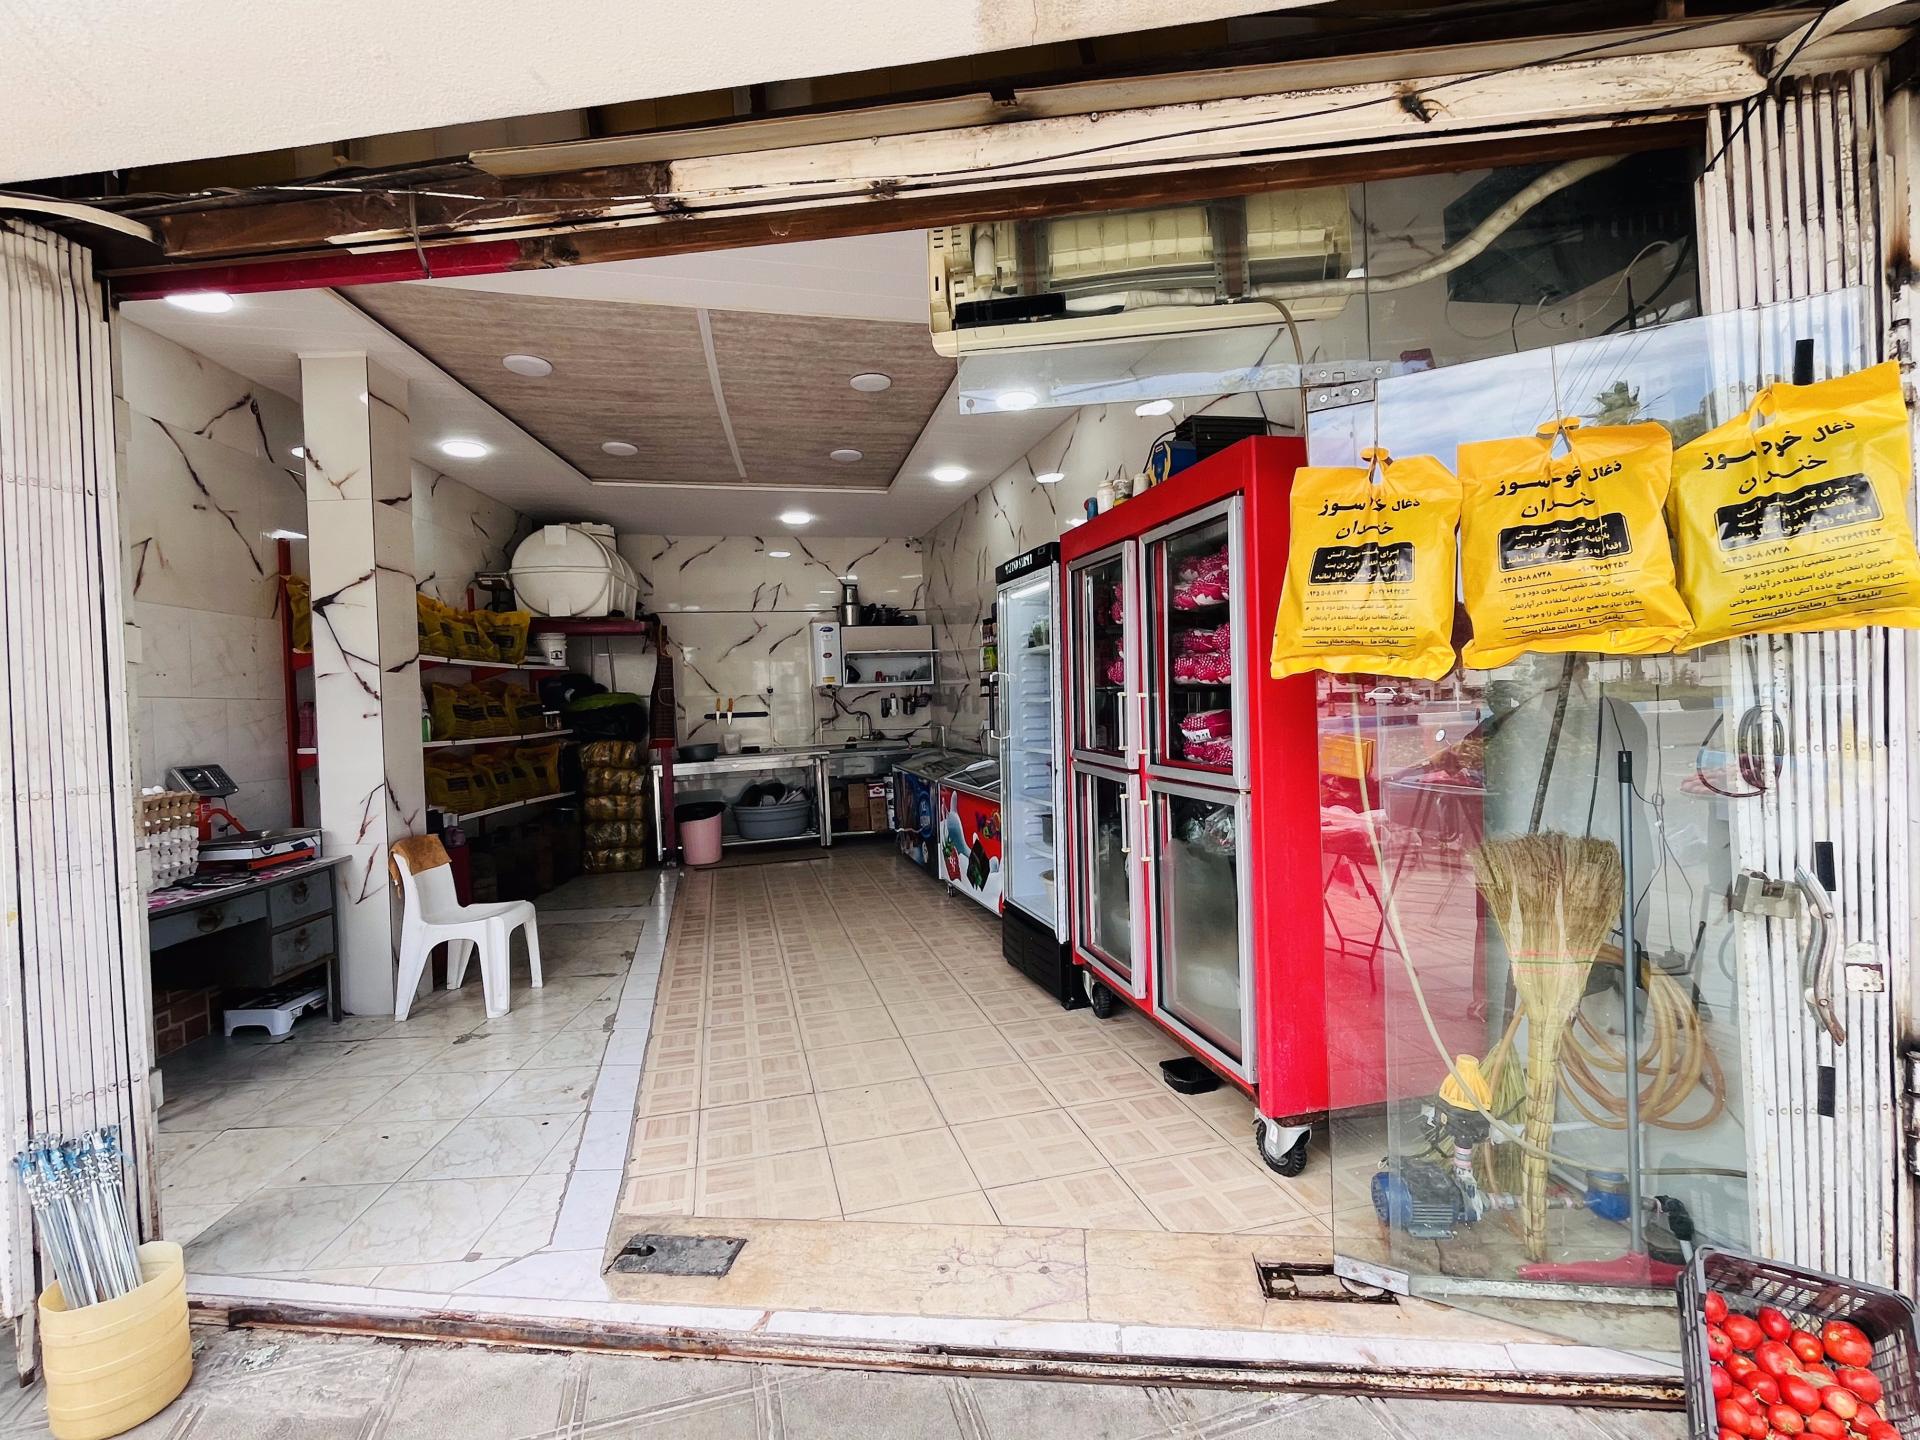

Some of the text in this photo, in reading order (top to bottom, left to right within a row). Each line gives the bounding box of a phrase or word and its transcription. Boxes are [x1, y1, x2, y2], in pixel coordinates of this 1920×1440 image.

[1812, 420, 1855, 442] ذغال
[1588, 460, 1622, 481] ذغال
[1738, 454, 1828, 494] خندن
[1820, 485, 1851, 498] برای
[1317, 497, 1420, 516] ذغال خسوز
[1819, 495, 1856, 508] بلافاصله
[1737, 500, 1761, 518] آتش
[1803, 504, 1818, 514] بعد
[1792, 509, 1801, 520] از
[1586, 522, 1608, 533] برای
[1737, 519, 1757, 528] بسته
[1515, 529, 1539, 540] آتش
[1570, 535, 1583, 543] بعد
[1561, 537, 1569, 546] از
[1547, 549, 1570, 559] نمودن
[1379, 559, 1399, 568] بلافاص
[1777, 564, 1799, 573] بدون
[1836, 562, 1863, 573] انتخاب
[1760, 568, 1776, 576] دود
[1817, 569, 1834, 580] برای
[1882, 570, 1905, 580] بدون
[1783, 571, 1816, 584] استفاده
[1738, 578, 1770, 594] آپارتمان
[1771, 579, 1782, 588] در
[1814, 583, 1833, 591] ماده
[1835, 580, 1852, 590] هیچ
[1785, 589, 1792, 598] زا
[1794, 584, 1814, 597] آتش
[1544, 596, 1571, 605] استفاده
[1571, 595, 1586, 603] برای
[1760, 593, 1776, 601] مواد
[1729, 598, 1758, 608] سوختی
[1553, 606, 1569, 616] آتش
[1586, 605, 1599, 613] هیچ
